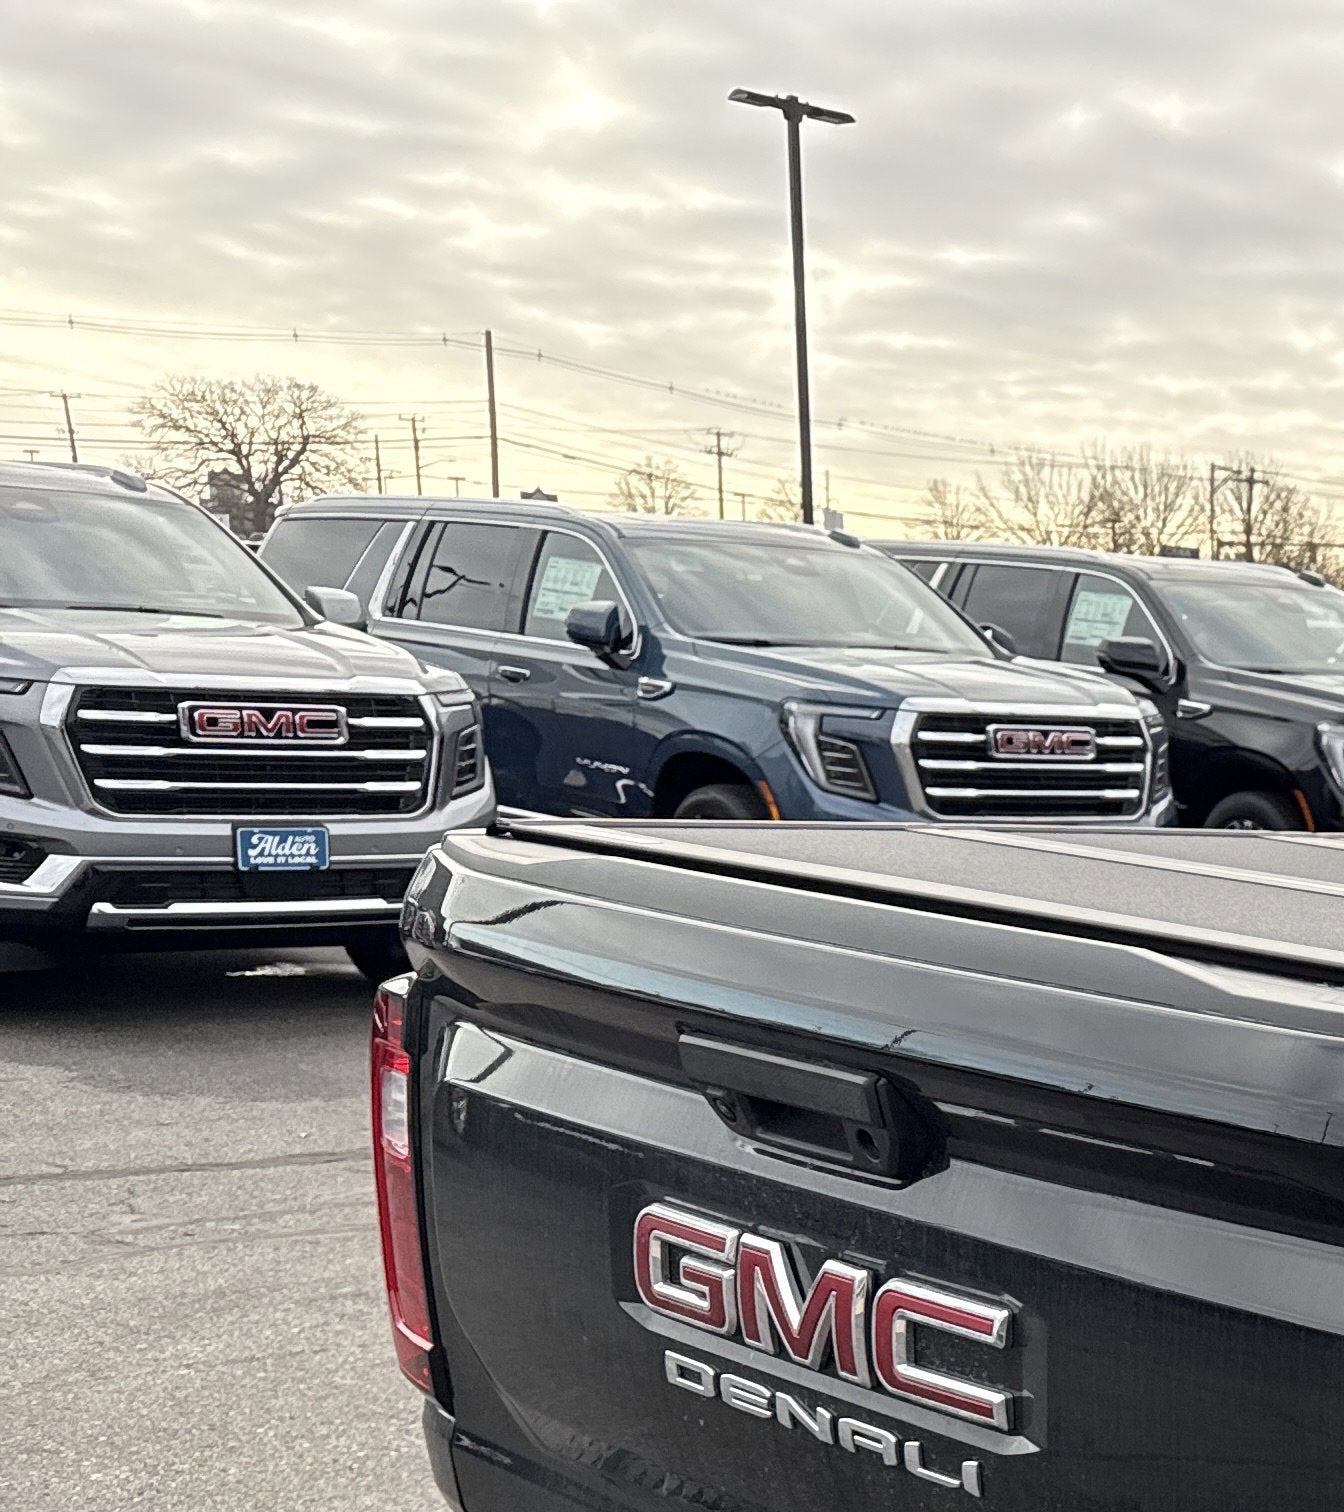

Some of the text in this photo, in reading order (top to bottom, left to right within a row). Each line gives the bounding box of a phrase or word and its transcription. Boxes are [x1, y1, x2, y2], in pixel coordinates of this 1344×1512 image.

[193, 708, 339, 738] GMC
[997, 731, 1092, 754] GMC
[247, 833, 320, 857] Alden
[634, 1202, 1014, 1433] GMC
[664, 1349, 983, 1498] DENALI
